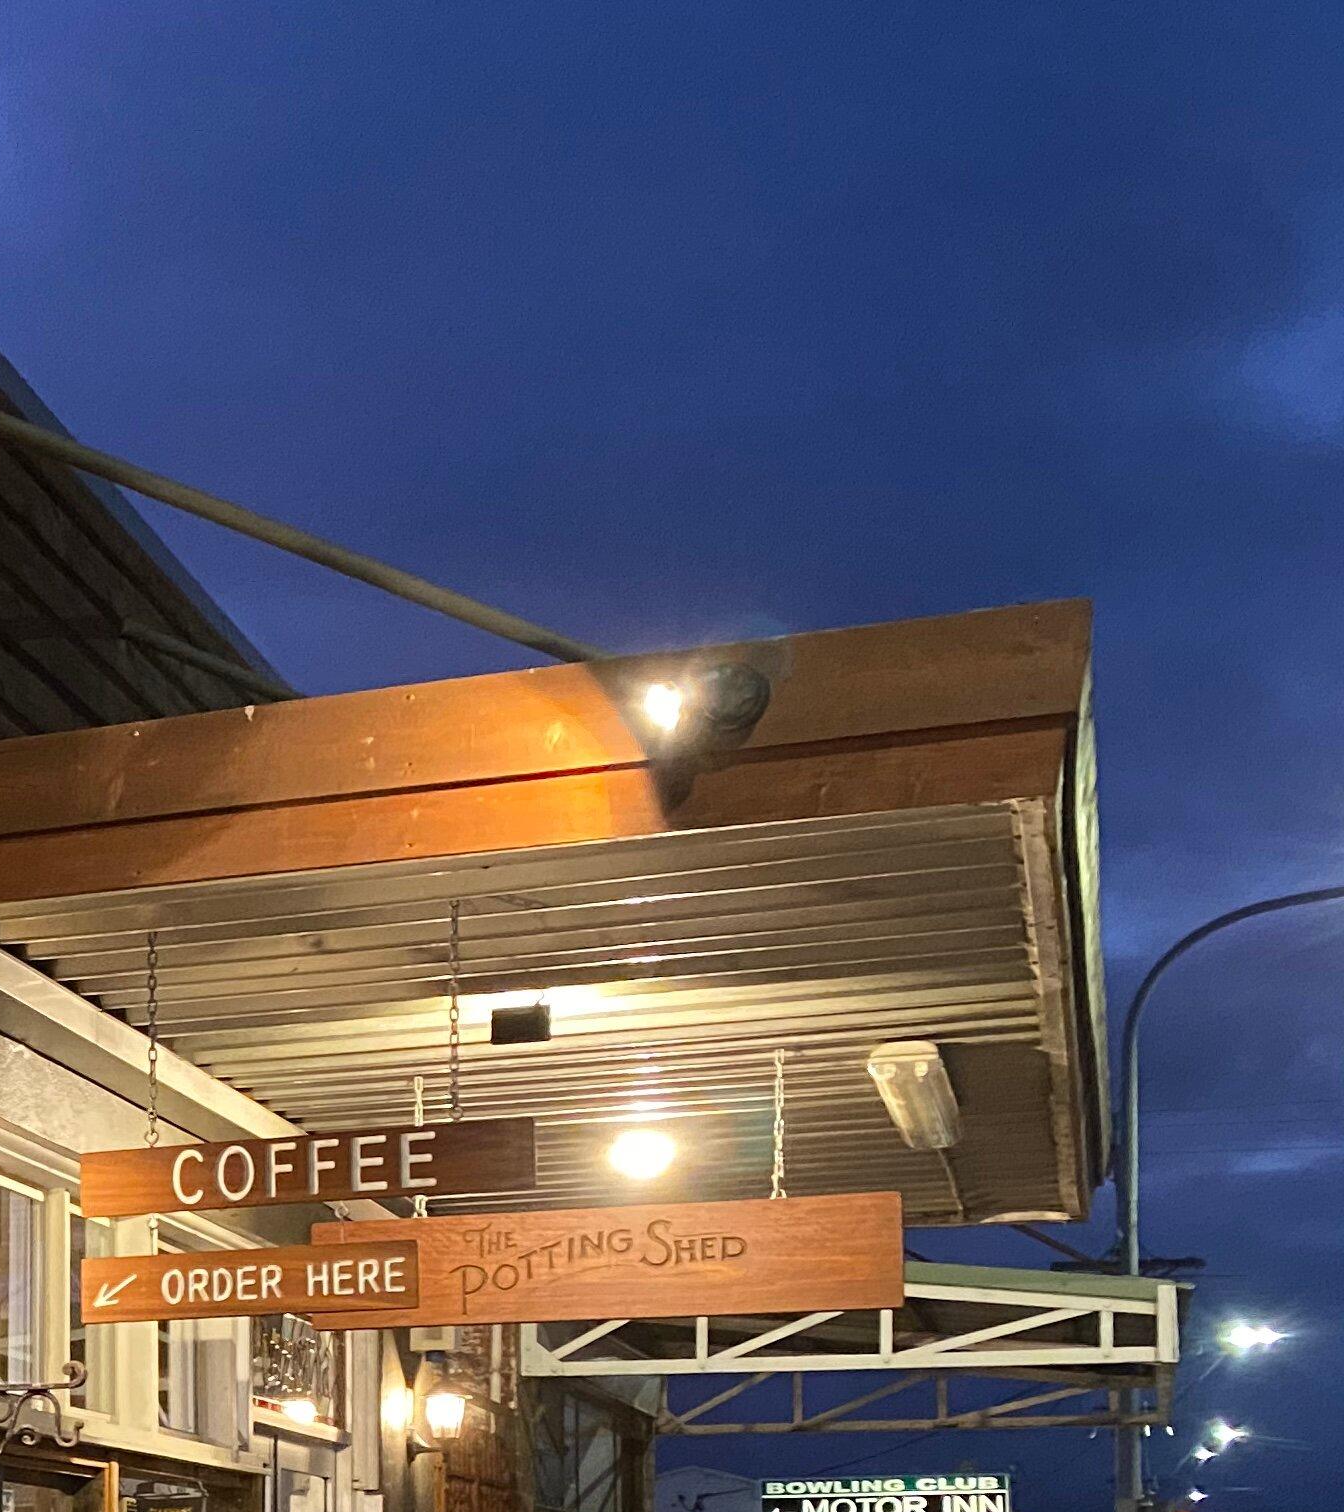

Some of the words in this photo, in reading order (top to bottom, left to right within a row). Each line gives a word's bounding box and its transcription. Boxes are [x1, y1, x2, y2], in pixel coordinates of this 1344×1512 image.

[171, 1131, 437, 1205] COFFEE
[463, 1222, 517, 1258] THE
[161, 1264, 283, 1305] ORDER
[307, 1256, 407, 1297] HERE
[449, 1229, 633, 1315] POTTING
[640, 1219, 747, 1266] SHED
[766, 1479, 905, 1494] BOWLING
[915, 1477, 1000, 1491] CLUB
